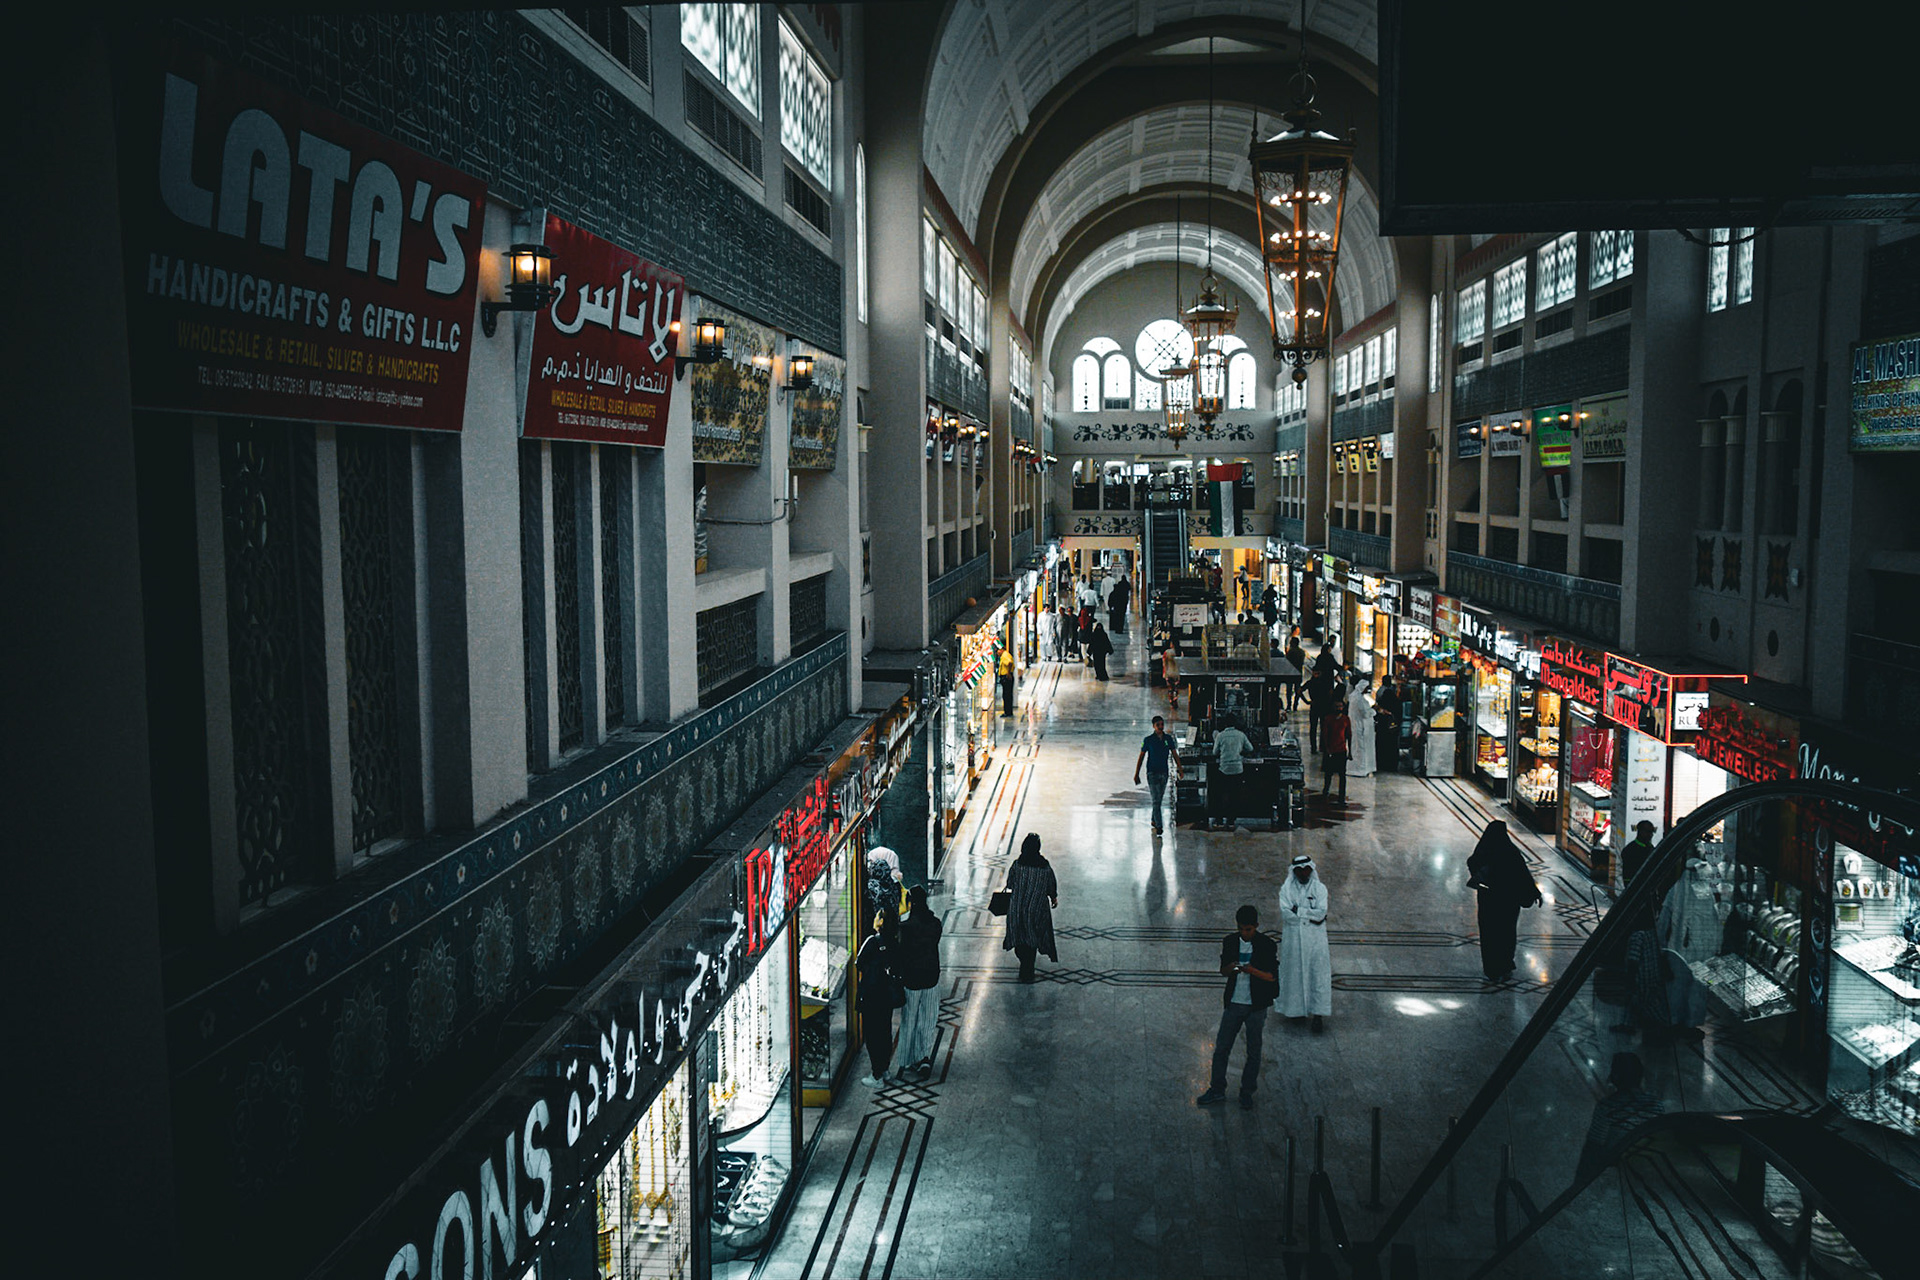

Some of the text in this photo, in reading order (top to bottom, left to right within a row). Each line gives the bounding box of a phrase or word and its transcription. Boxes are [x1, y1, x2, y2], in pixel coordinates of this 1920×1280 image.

[159, 71, 471, 295] LATA'S
[146, 252, 462, 353] HANDICRAFTS & GIFTS L.L.C
[177, 320, 260, 360] WHOLESALE
[264, 337, 273, 361] &
[327, 346, 363, 374] SILVER
[366, 354, 374, 375] &
[377, 356, 440, 384] HANDICRAFTS
[1852, 346, 1872, 385] AL
[584, 357, 623, 391] الهدايا
[624, 371, 632, 395] و
[633, 366, 668, 395] للتحف
[551, 389, 583, 410] WHOLESALE
[1893, 391, 1902, 407] OF
[1541, 662, 1600, 706] Mangaldas
[1614, 694, 1642, 729] RUBY
[1713, 740, 1778, 783] JEWELLERS
